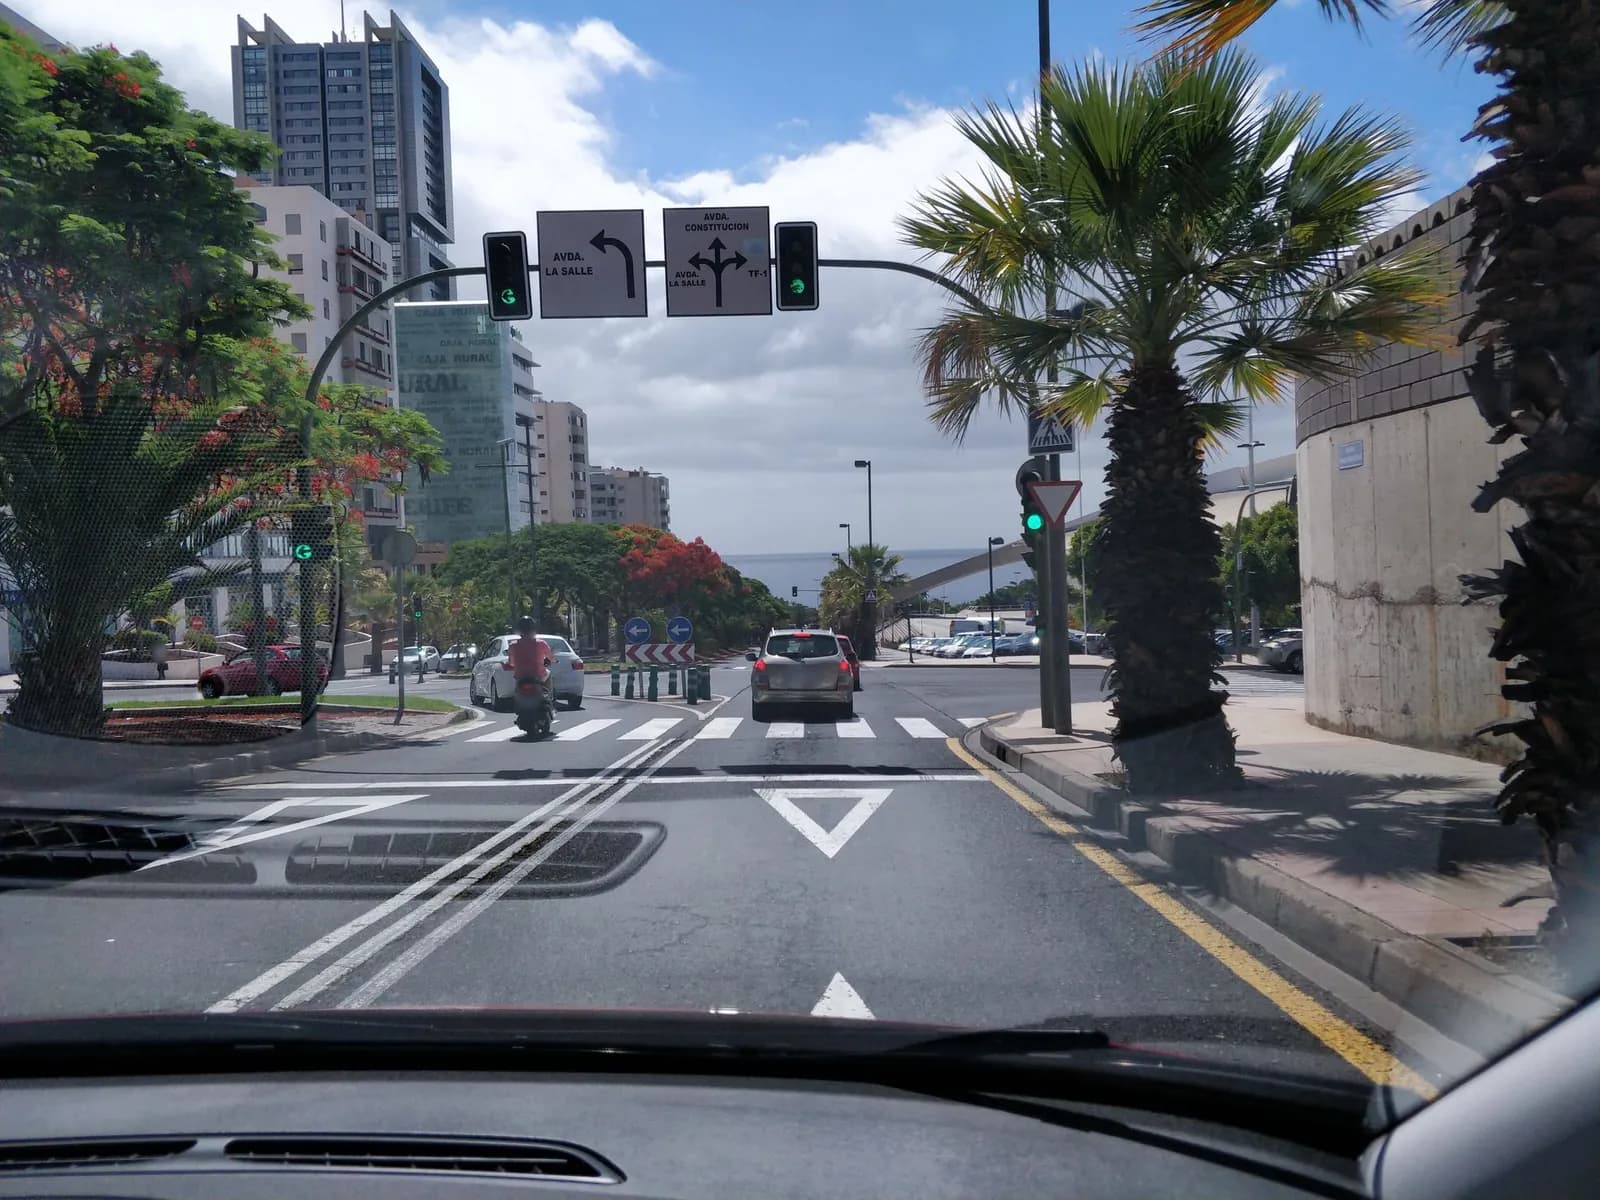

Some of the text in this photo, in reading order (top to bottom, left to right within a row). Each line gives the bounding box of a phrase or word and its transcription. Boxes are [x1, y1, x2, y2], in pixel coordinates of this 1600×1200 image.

[704, 212, 730, 221] AVDA.
[685, 222, 750, 232] CONSTITUCION
[553, 252, 585, 262] AVDA.
[545, 266, 593, 277] LA SALLE
[748, 270, 768, 279] TF-1
[669, 279, 706, 288] LA SALLE
